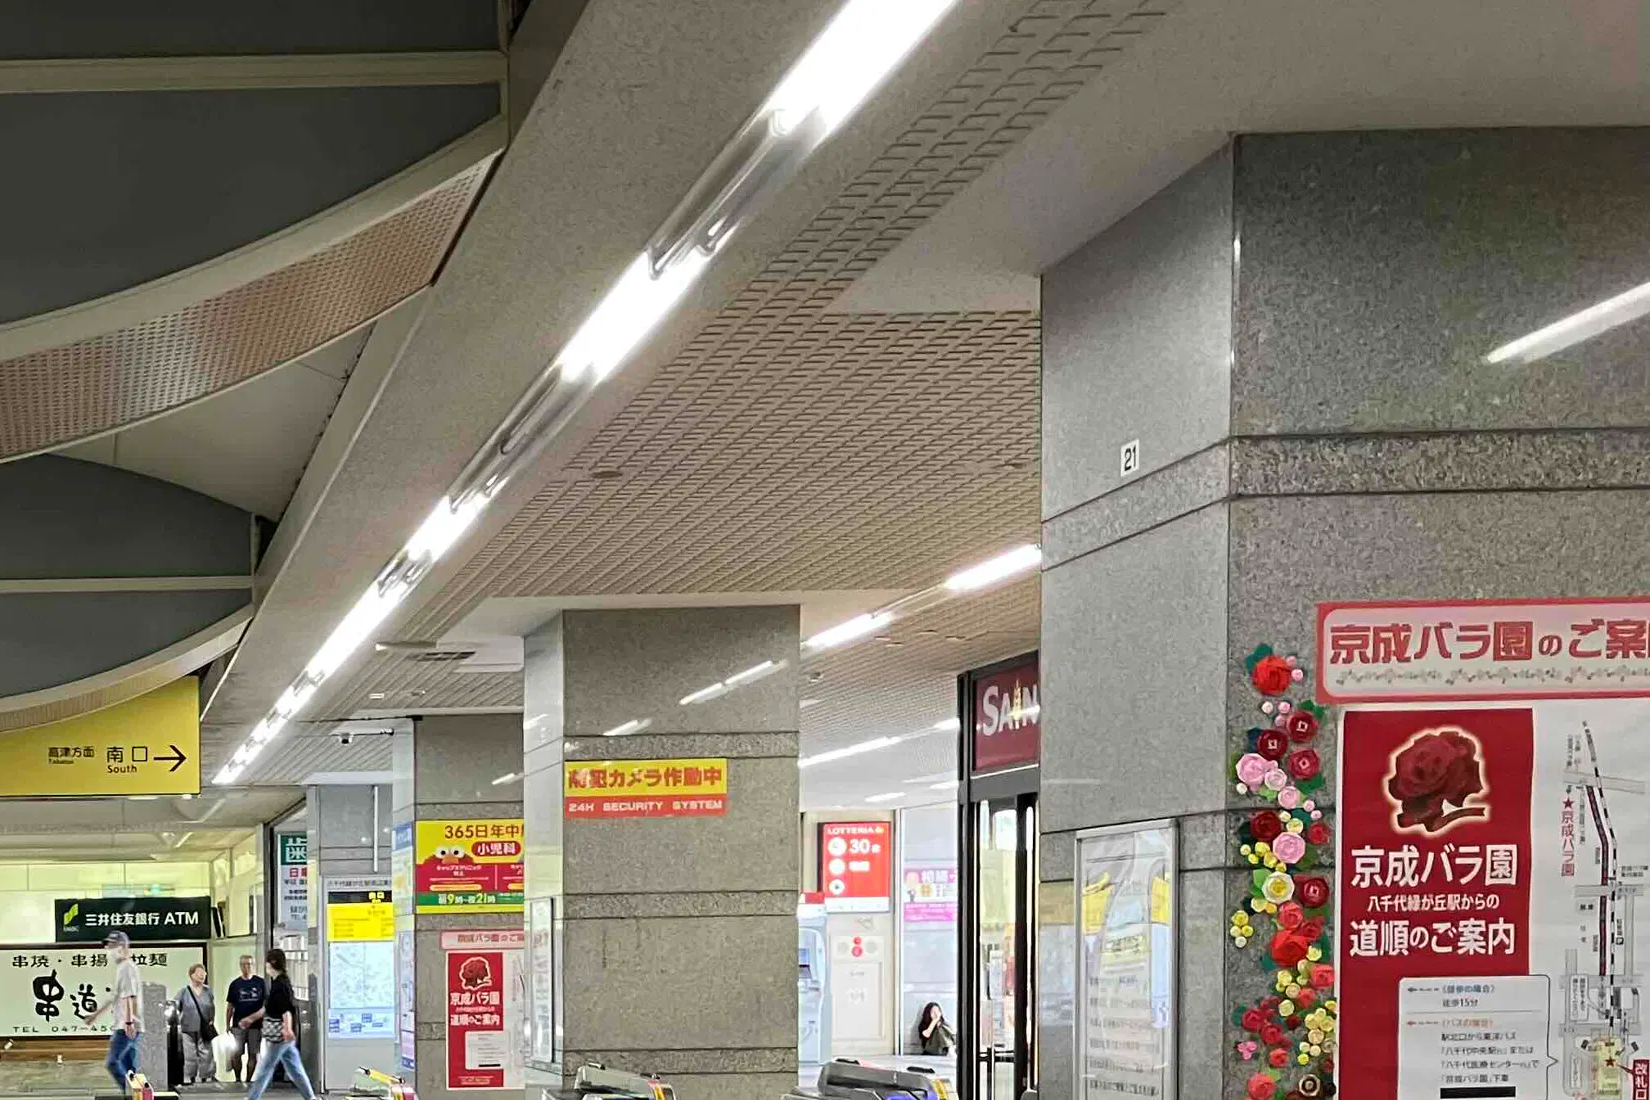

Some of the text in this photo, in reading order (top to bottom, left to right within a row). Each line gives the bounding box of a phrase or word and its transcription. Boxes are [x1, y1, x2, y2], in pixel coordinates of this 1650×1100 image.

[1123, 445, 1137, 472] 21
[1329, 617, 1650, 665] 京成バラ園のご案
[48, 745, 95, 759] 高津方面
[106, 745, 148, 764] 南口
[106, 764, 138, 774] South
[567, 767, 723, 789] 防犯カメラ作動中
[568, 799, 723, 813] 24H SECURITY SYSTEM
[444, 823, 524, 839] 365日年中
[827, 826, 875, 835] LOTTERIA
[477, 842, 516, 855] 小児科
[1560, 809, 1576, 877] 京成バラ園
[1351, 843, 1518, 889] 京成バラ園
[1367, 893, 1500, 913] 八千代緑が丘駅からの
[84, 911, 199, 927] 三井住友銀行 ATM
[1349, 916, 1516, 958] 道順のご案内
[32, 968, 113, 1022] 串道
[449, 992, 501, 1006] 京成バラ園
[1442, 998, 1479, 1008] 徒歩15分
[12, 1026, 40, 1034] TEL
[1634, 1061, 1649, 1100] 改札口
